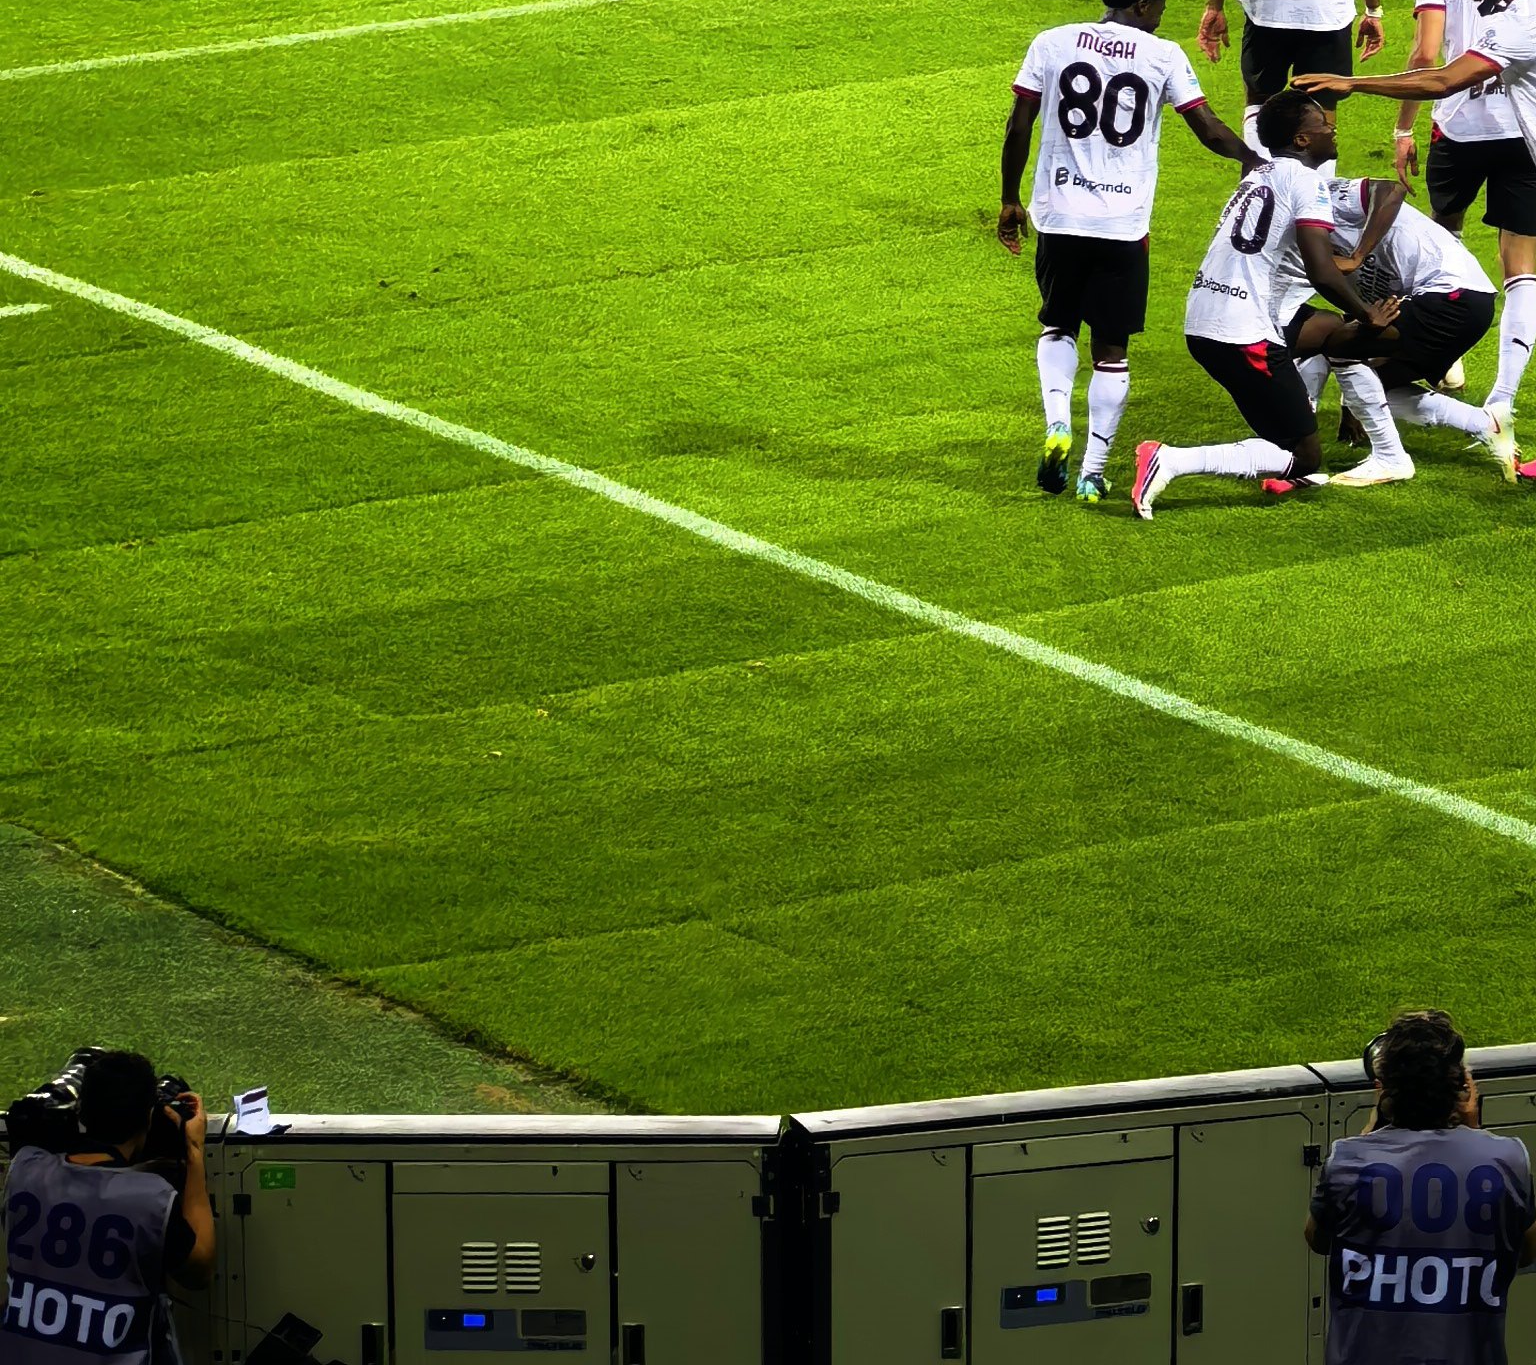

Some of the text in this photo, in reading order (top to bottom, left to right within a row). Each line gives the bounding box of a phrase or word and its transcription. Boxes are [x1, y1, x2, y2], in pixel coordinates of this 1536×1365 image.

[1076, 31, 1137, 60] MUSAH
[1057, 61, 1150, 148] 80
[7, 1191, 136, 1280] 286
[4, 1272, 136, 1349] HOTO
